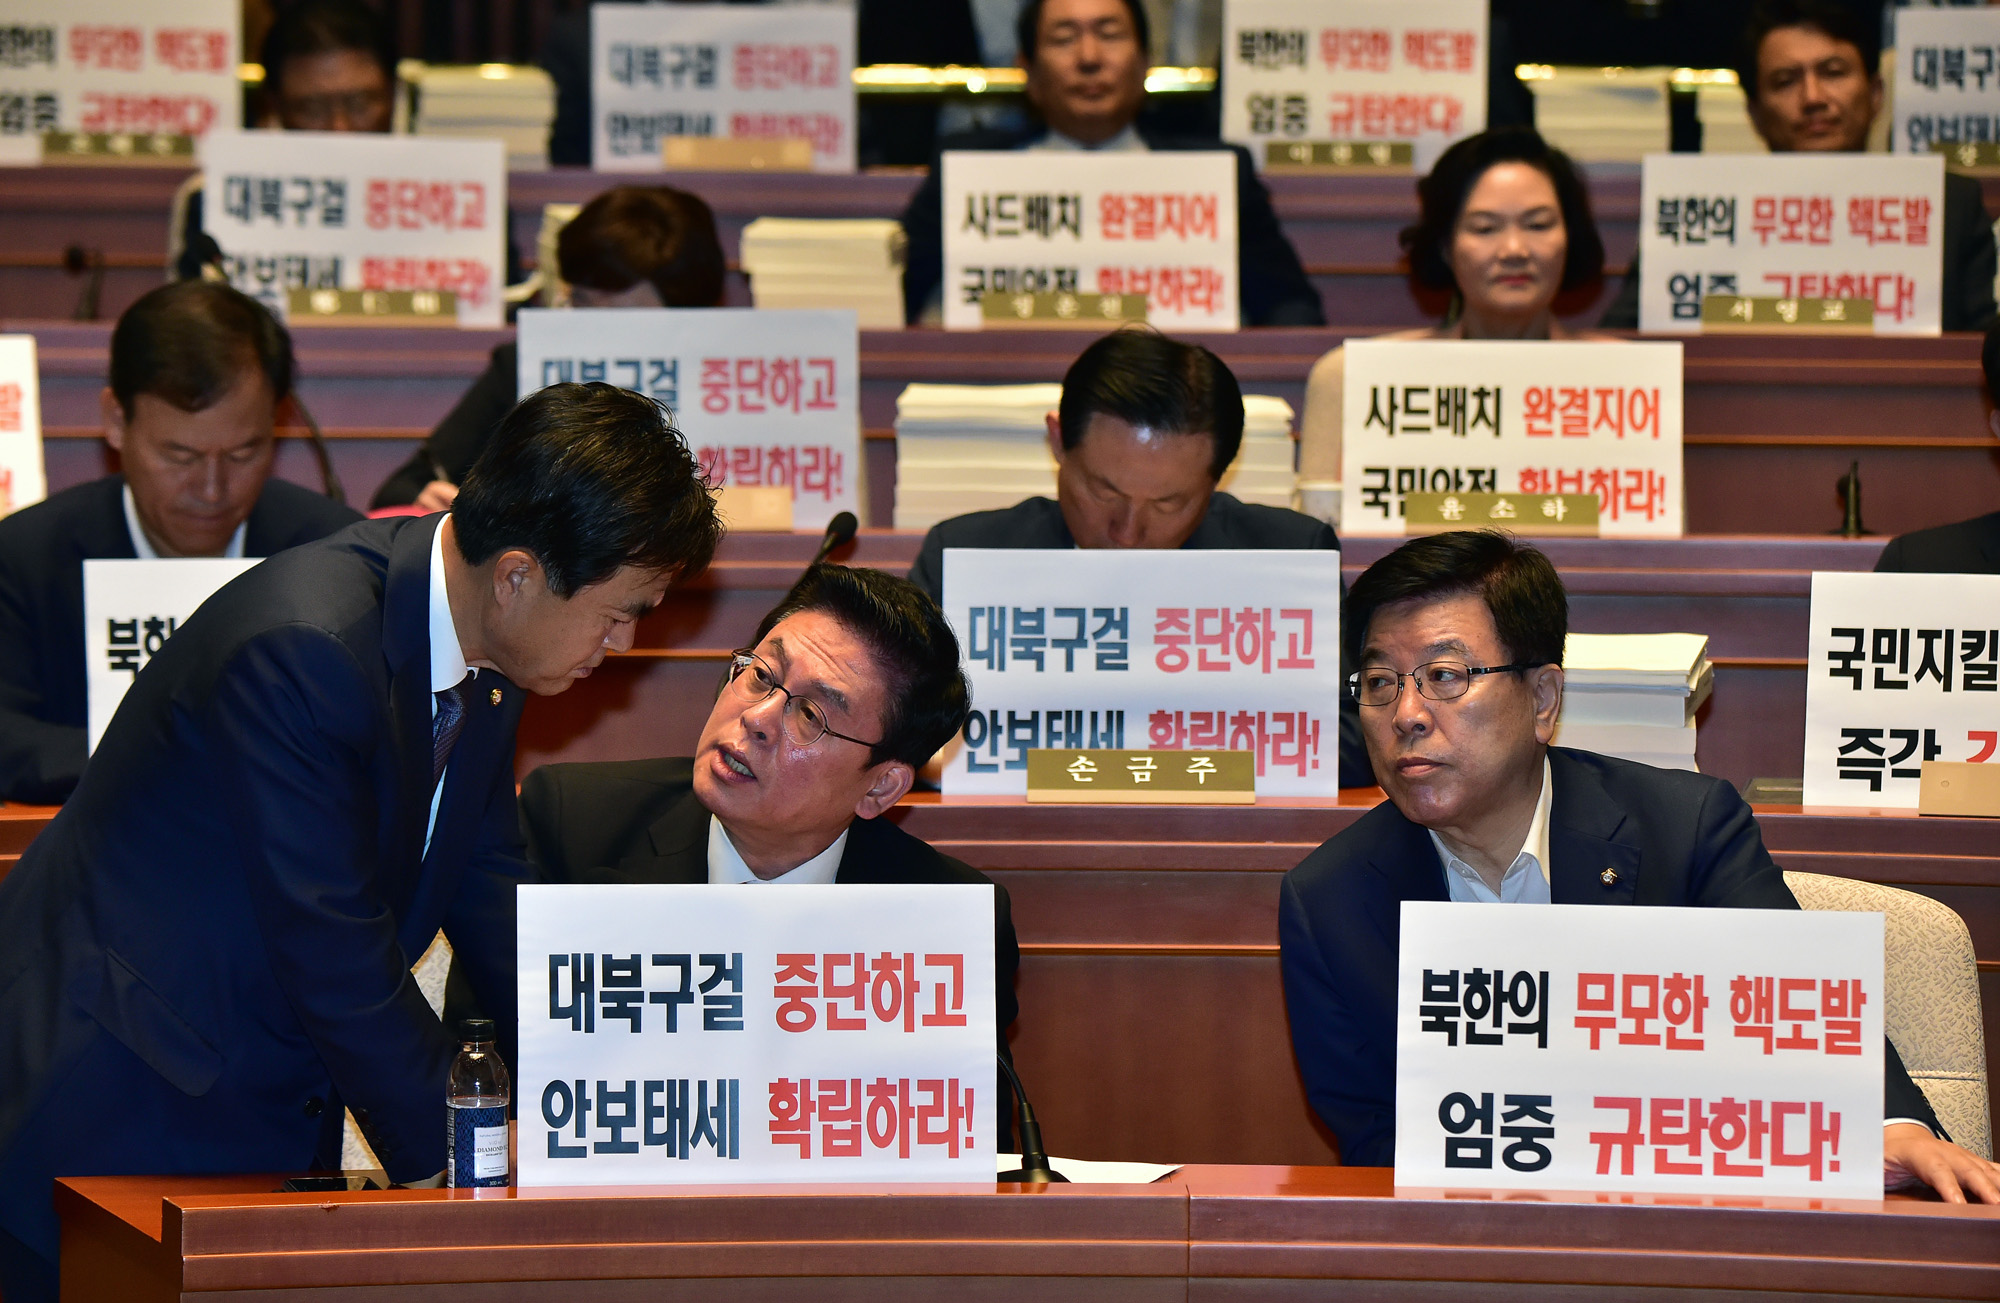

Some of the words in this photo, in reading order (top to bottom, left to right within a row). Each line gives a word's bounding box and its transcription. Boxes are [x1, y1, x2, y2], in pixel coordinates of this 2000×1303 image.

[224, 175, 346, 227] 대북구걸
[366, 177, 486, 231] 중단하고
[962, 192, 1082, 241] 사드배치
[1099, 192, 1218, 243] 완결지어
[1658, 195, 1736, 246] 북한의
[1752, 196, 1833, 246] 무모한
[1847, 195, 1932, 247] 핵도발
[701, 356, 838, 415] 중단하고
[1364, 384, 1502, 437] 사드배치
[1522, 386, 1661, 440] 완결지어
[1437, 495, 1569, 522] 윤소하
[968, 606, 1130, 673] 대북구걸
[1153, 606, 1316, 674] 중단하고
[1827, 627, 2000, 693] 국민지킬
[1065, 754, 1218, 785] 손금주
[547, 952, 744, 1034] 대북구걸
[773, 951, 967, 1033] 중단하고
[1419, 967, 1549, 1049] 북한의
[1574, 972, 1709, 1052] 무모한
[1729, 974, 1867, 1056] 핵도발
[541, 1078, 740, 1160] 안보태세
[767, 1076, 974, 1160] 확립하라!
[1437, 1091, 1555, 1172] 엄중
[1589, 1096, 1842, 1182] 규탄한다!
